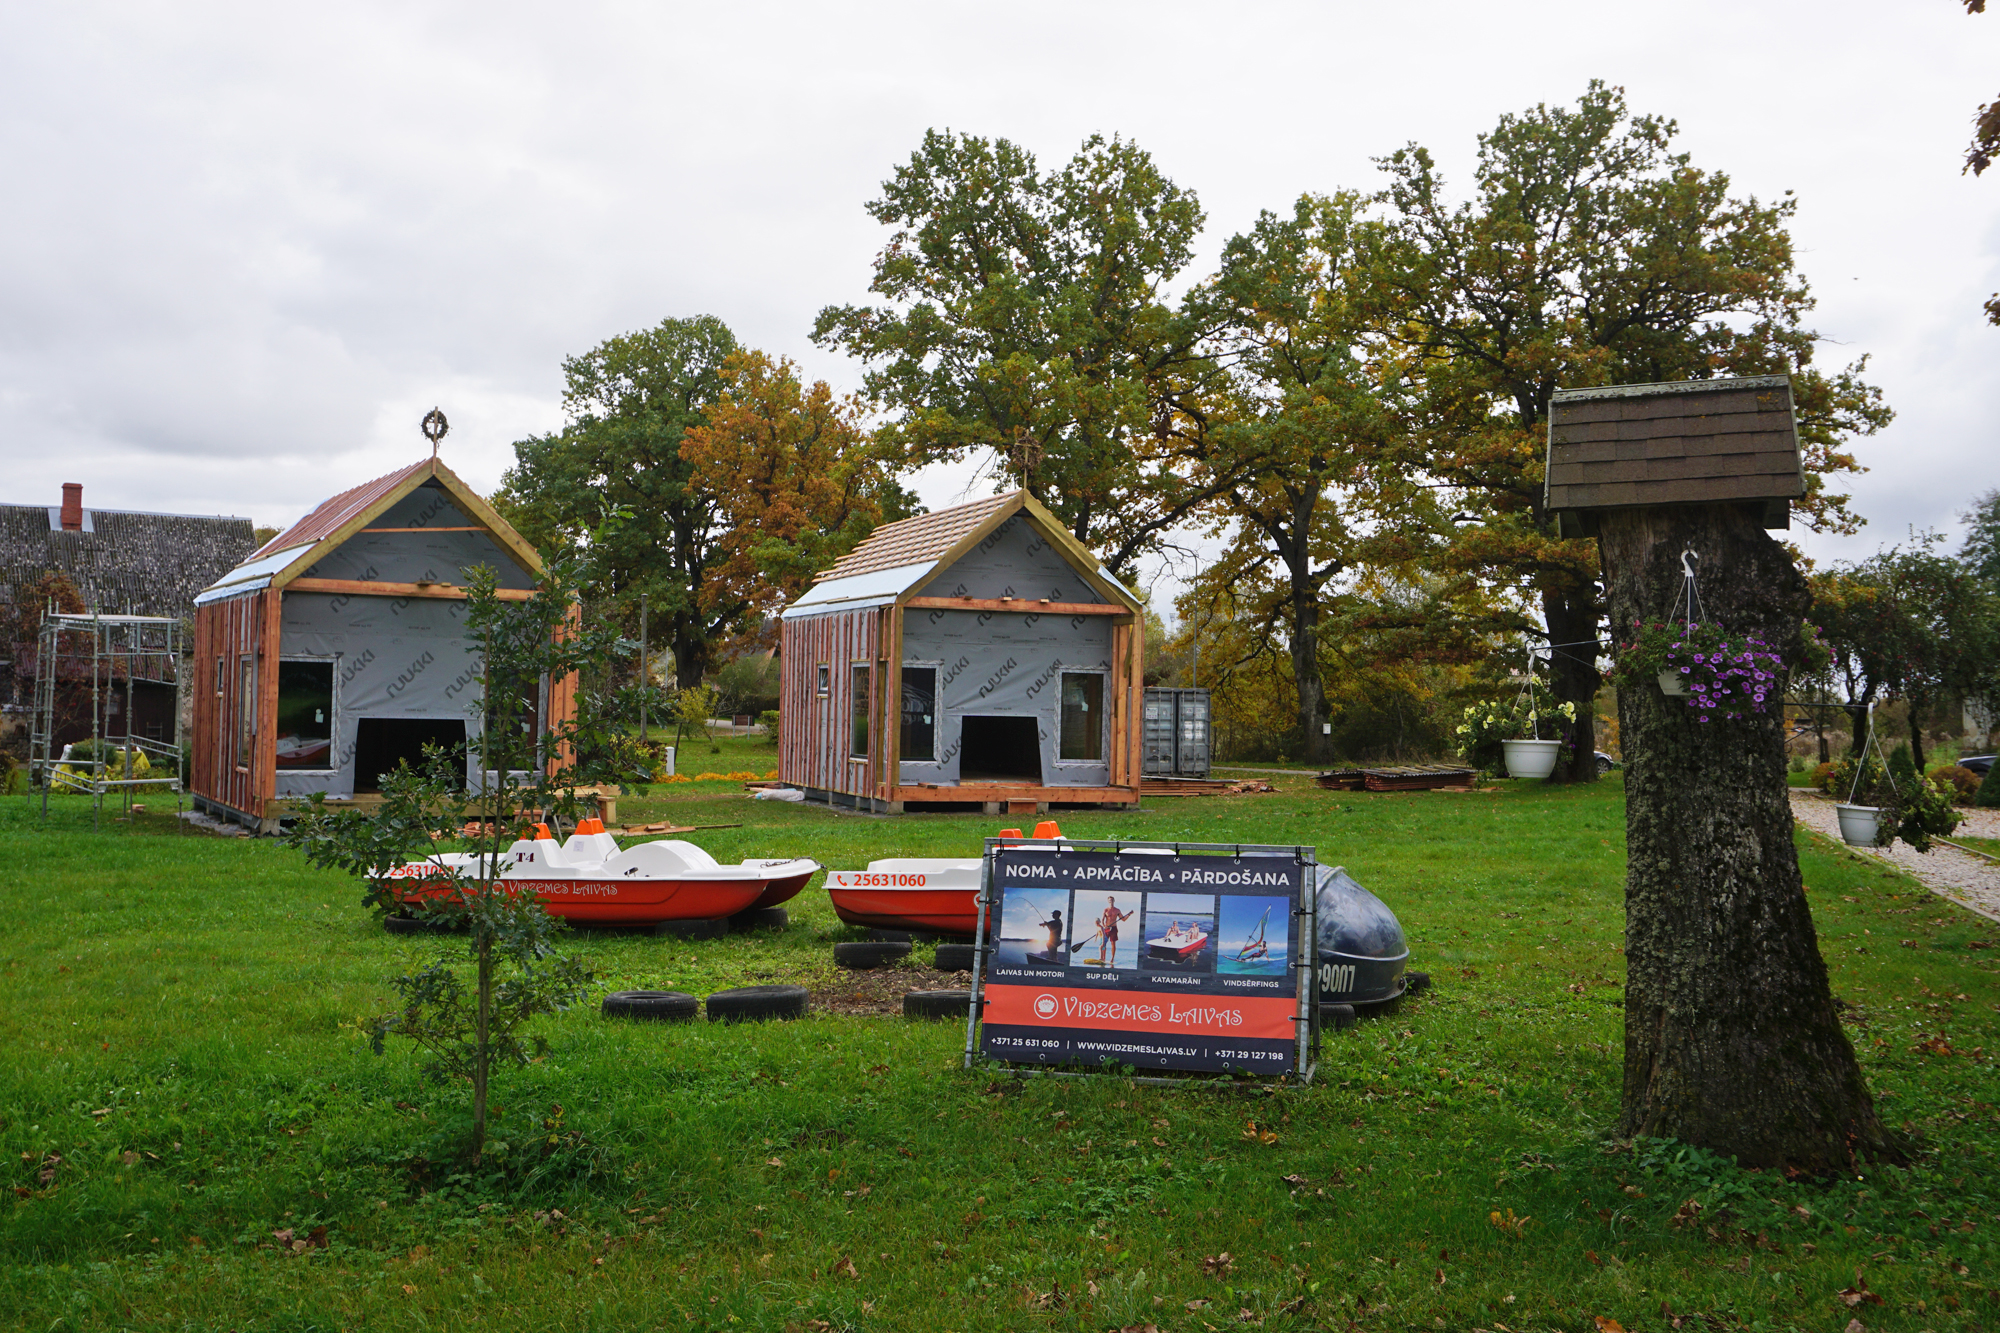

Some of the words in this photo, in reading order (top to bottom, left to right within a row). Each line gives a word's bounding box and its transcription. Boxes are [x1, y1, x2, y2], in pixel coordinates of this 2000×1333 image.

[515, 852, 535, 863] T4
[853, 873, 926, 887] 25631060
[1005, 864, 1057, 879] NOMA
[1073, 865, 1164, 883] APMĀCĪBA
[1181, 868, 1290, 886] PĀRDOŠANA
[572, 881, 618, 897] LAIVAS
[996, 968, 1022, 977] LAIVAS
[1023, 969, 1035, 977] UN
[1035, 970, 1065, 978] MOTORI
[1085, 972, 1101, 980] SUP
[1151, 976, 1201, 985] KATAMARĀNI
[1223, 979, 1280, 988] VINDSĒRFINGS
[1063, 995, 1162, 1022] VIDZEMES
[1168, 1003, 1243, 1028] LAIVAS
[991, 1037, 1011, 1046] +371
[1012, 1038, 1024, 1047] 25
[1025, 1039, 1040, 1047] 631
[1041, 1039, 1060, 1049] 060
[1077, 1041, 1198, 1057] WWW.VIDZEMESLAIVAS.LV
[1215, 1049, 1236, 1059] +371
[1237, 1051, 1249, 1060] 29
[1251, 1051, 1266, 1060] 127
[1268, 1052, 1284, 1061] 198
